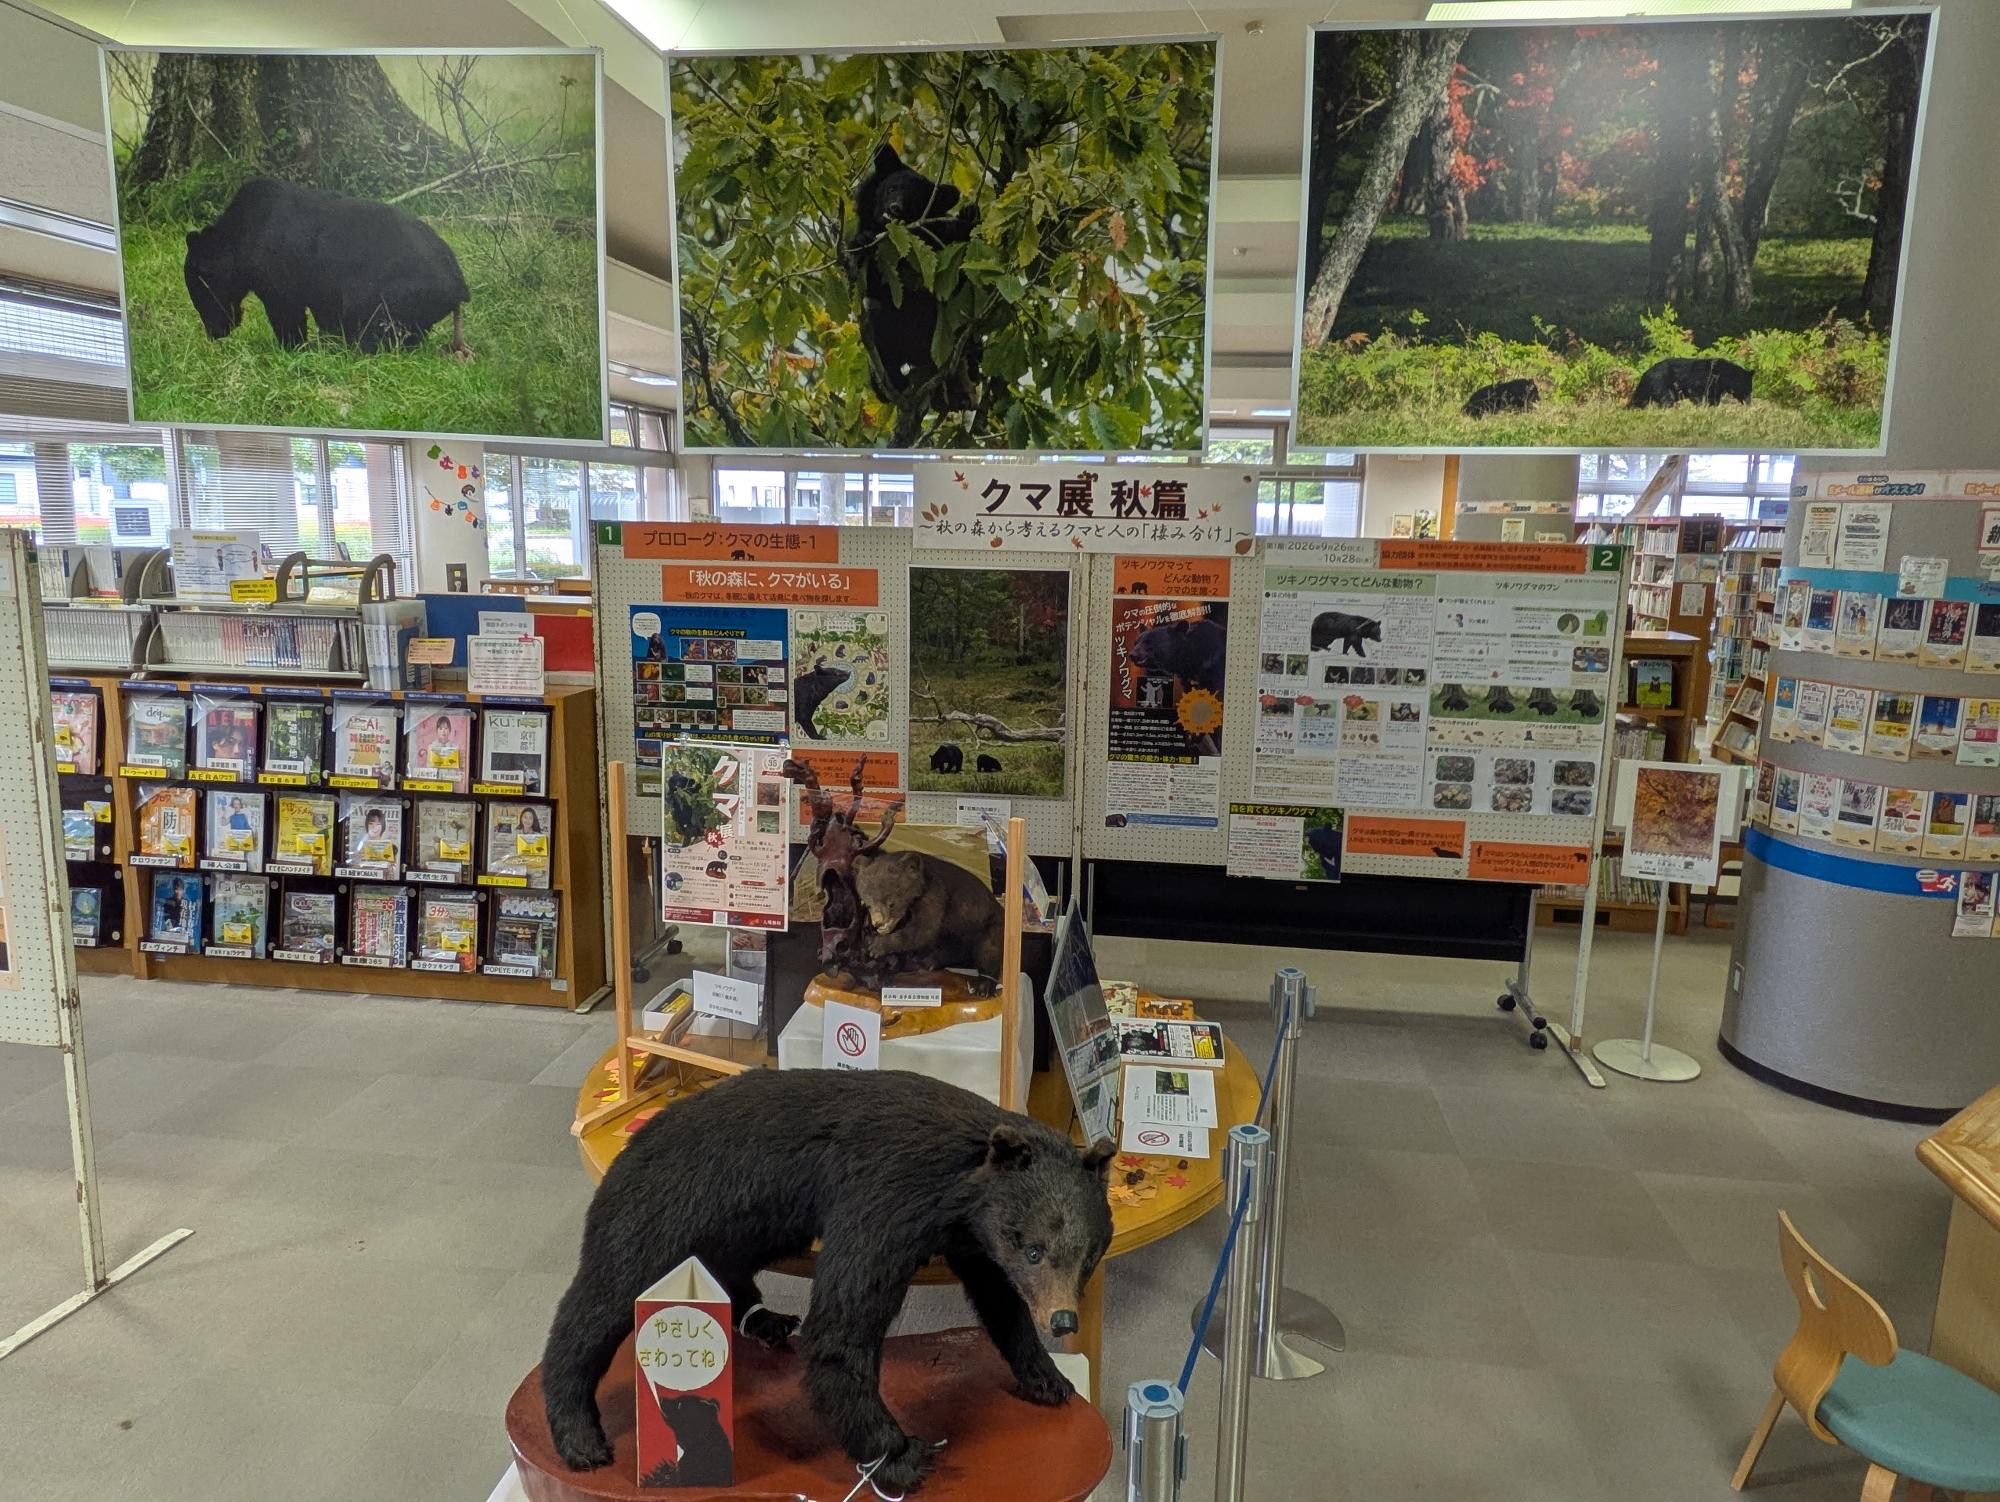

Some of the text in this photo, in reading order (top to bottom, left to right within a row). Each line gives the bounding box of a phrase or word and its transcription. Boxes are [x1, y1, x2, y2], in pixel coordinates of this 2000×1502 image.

[981, 477, 1189, 520] クマ展 秋篇
[605, 526, 613, 541] 1
[1121, 560, 1194, 571] ツキノワグマって
[1599, 550, 1613, 567] 2
[688, 569, 851, 591] 「秋の森に、クマがいる」
[1163, 573, 1220, 585] どんな動物？
[1277, 574, 1424, 590] ツキノワグマってどんな動物？
[1114, 635, 1133, 700] ツキノワグマ
[1230, 804, 1316, 816] 森を育てるツキノワグマ
[131, 858, 171, 866] クロワッサン
[413, 873, 449, 882] 天然生活
[653, 1317, 715, 1340] やさしく
[638, 1347, 728, 1369] さわってね！
